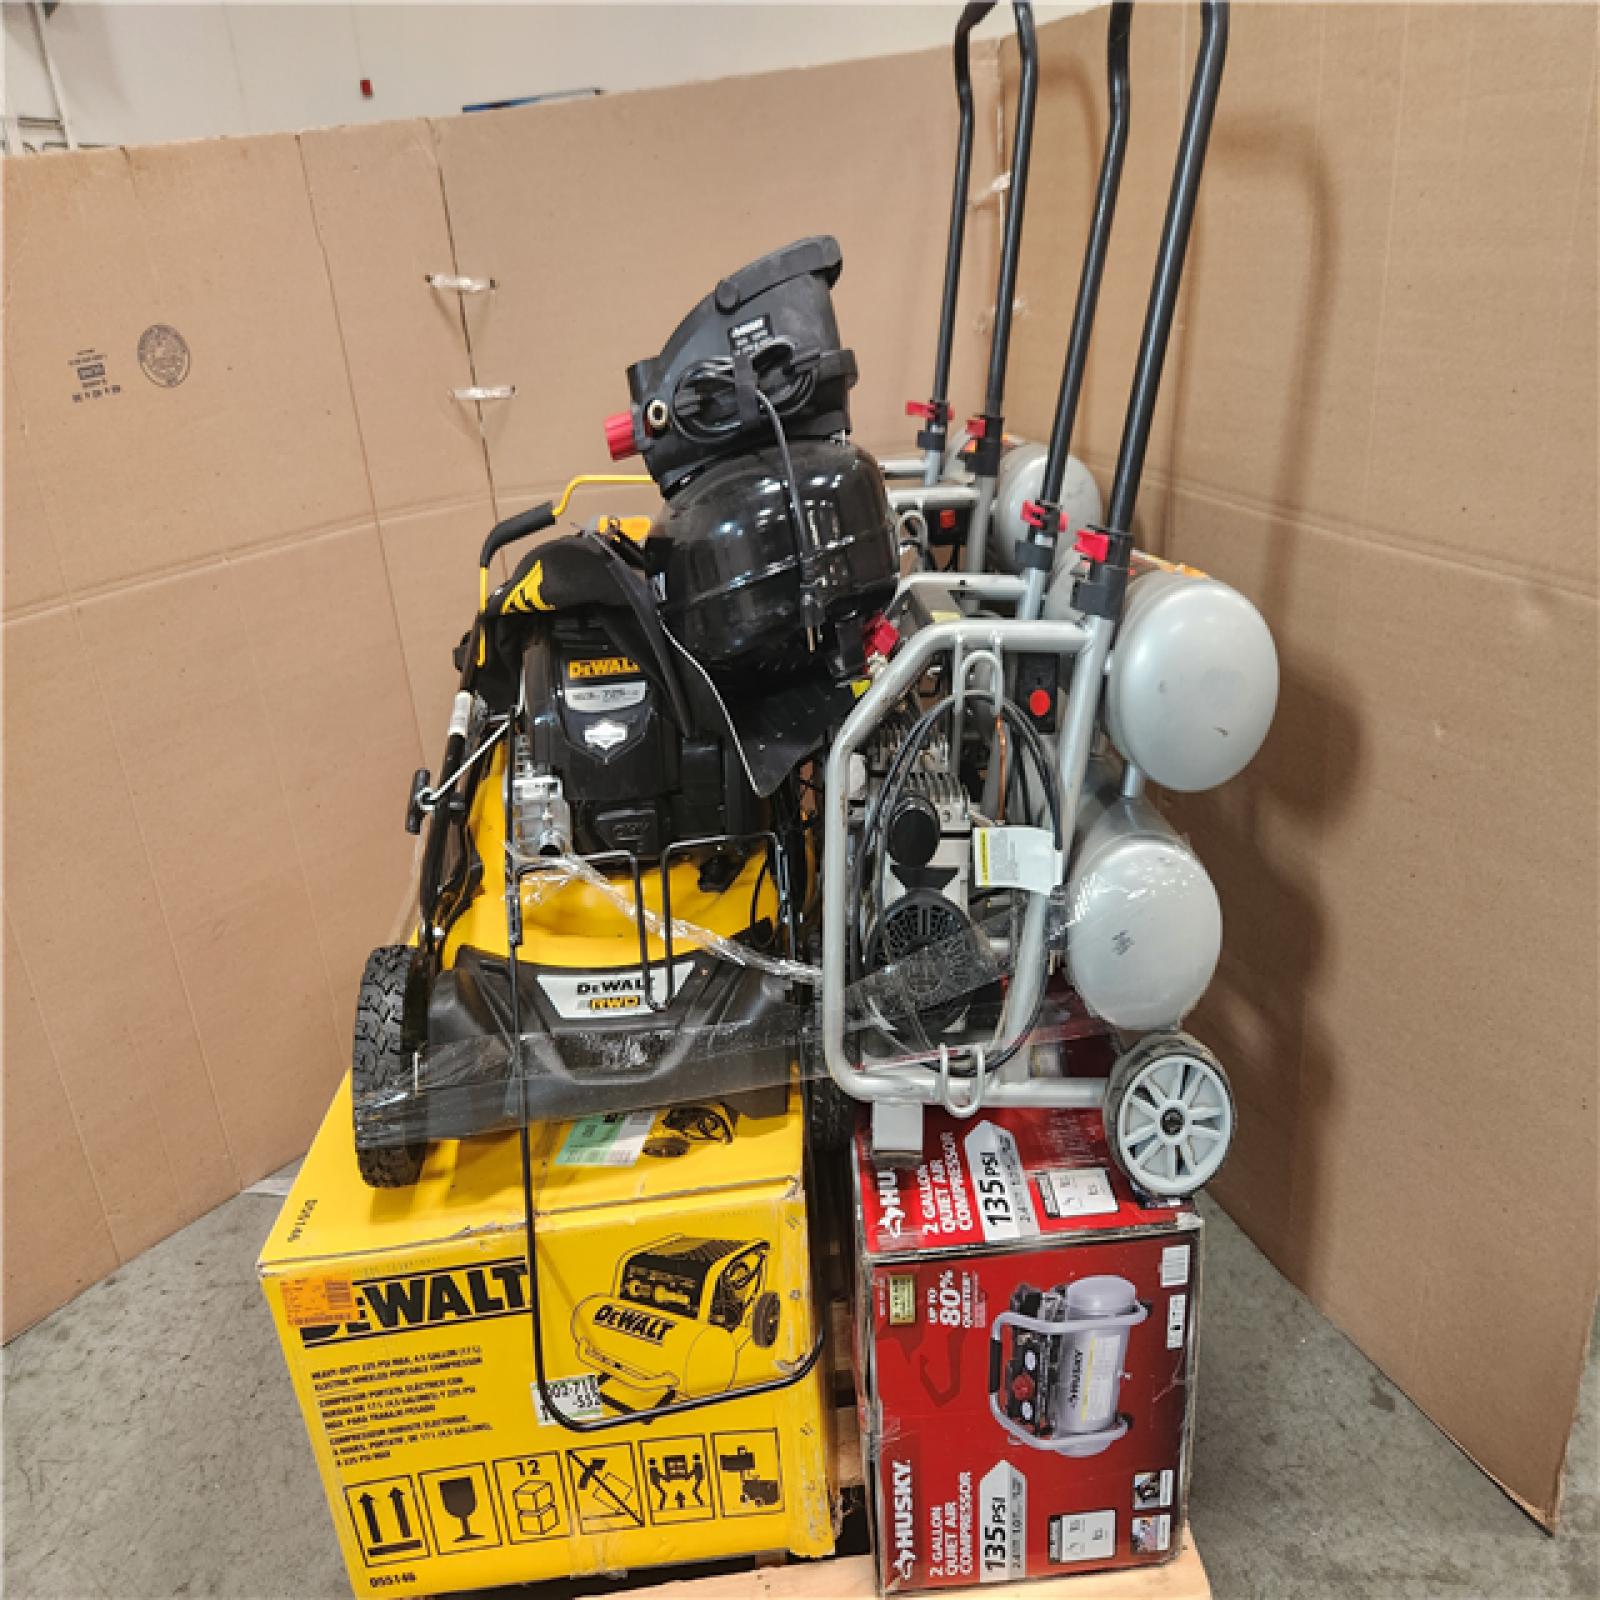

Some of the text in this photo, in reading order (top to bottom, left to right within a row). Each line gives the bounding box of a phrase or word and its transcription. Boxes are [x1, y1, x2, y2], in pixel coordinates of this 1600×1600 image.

[929, 1159, 956, 1233] QUIET AIR
[940, 1131, 973, 1231] COMPRESSOR
[980, 1151, 1001, 1177] PSI
[916, 1164, 939, 1235] 2 GALLON
[978, 1179, 1013, 1227] 135
[594, 1304, 674, 1342] DEWALT
[939, 1269, 961, 1327] 80%
[515, 1460, 541, 1477] 12
[930, 1507, 943, 1577] 2 GALLON
[944, 1502, 958, 1576] QUIET AIR
[959, 1471, 973, 1576] COMPRESSOR
[984, 1497, 1006, 1572] 135 PSI
